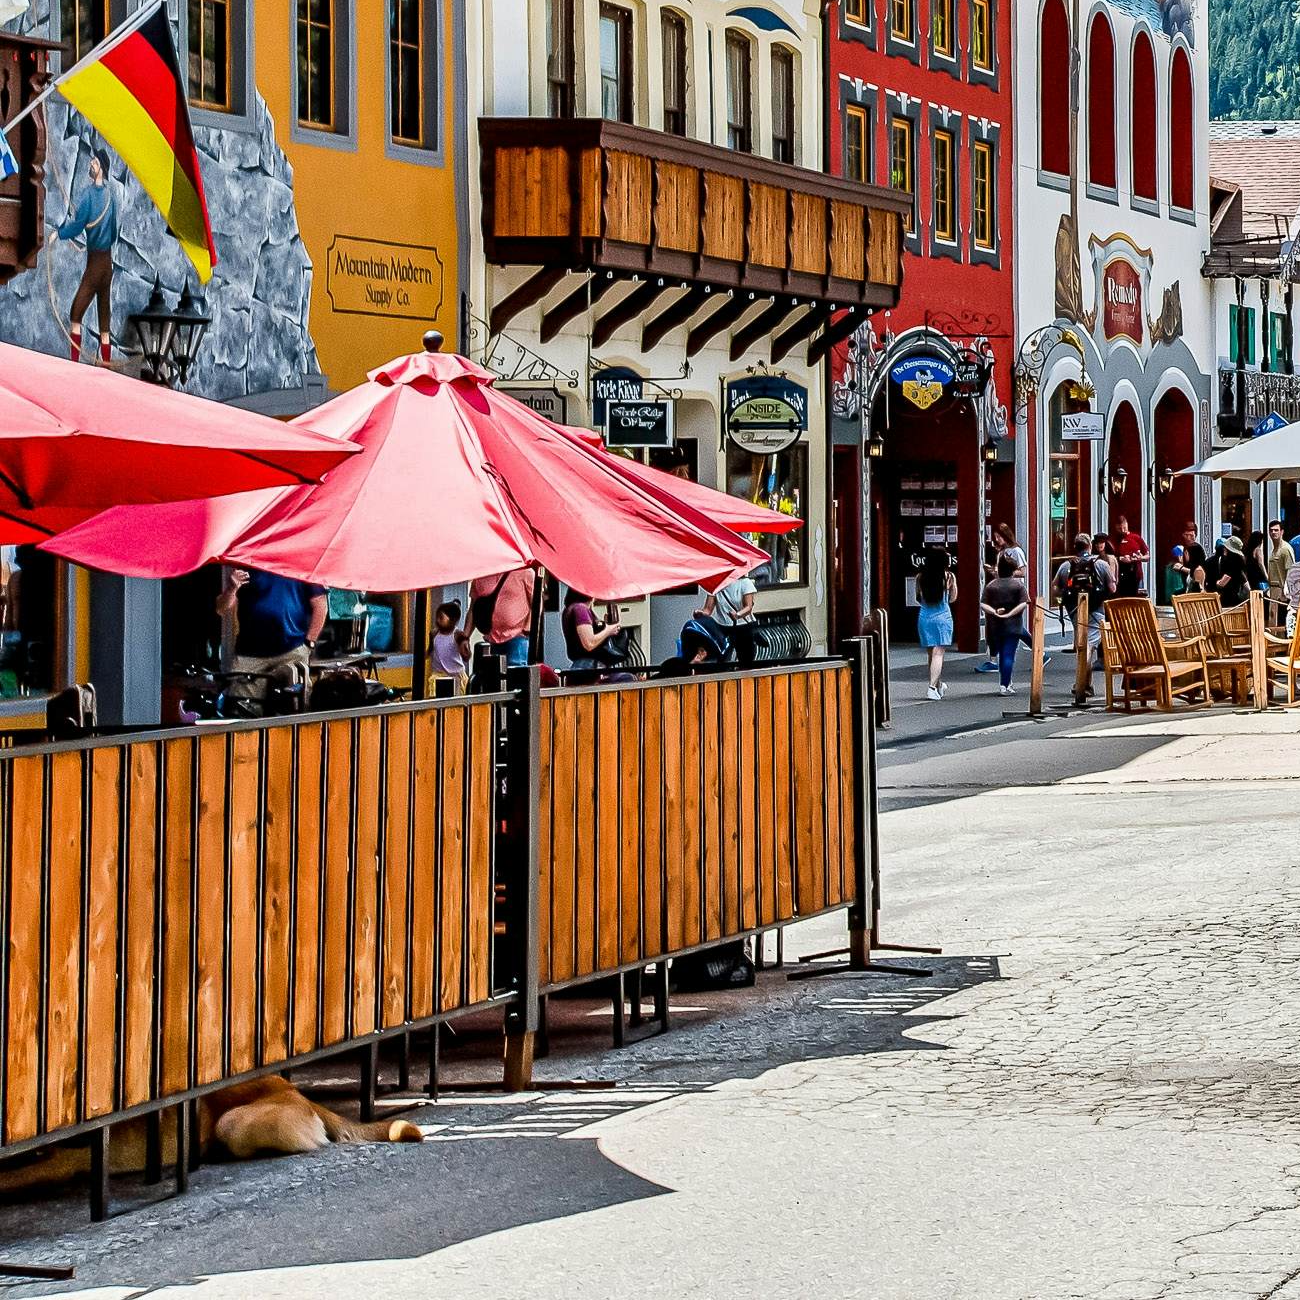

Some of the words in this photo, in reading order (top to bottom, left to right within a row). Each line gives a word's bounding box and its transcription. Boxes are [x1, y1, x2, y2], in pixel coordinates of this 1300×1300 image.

[335, 250, 389, 280] Mountain
[390, 256, 433, 285] Modern
[366, 284, 393, 308] Supply
[396, 288, 410, 306] Co.
[746, 404, 781, 414] INSIDE
[1063, 417, 1081, 429] KW
